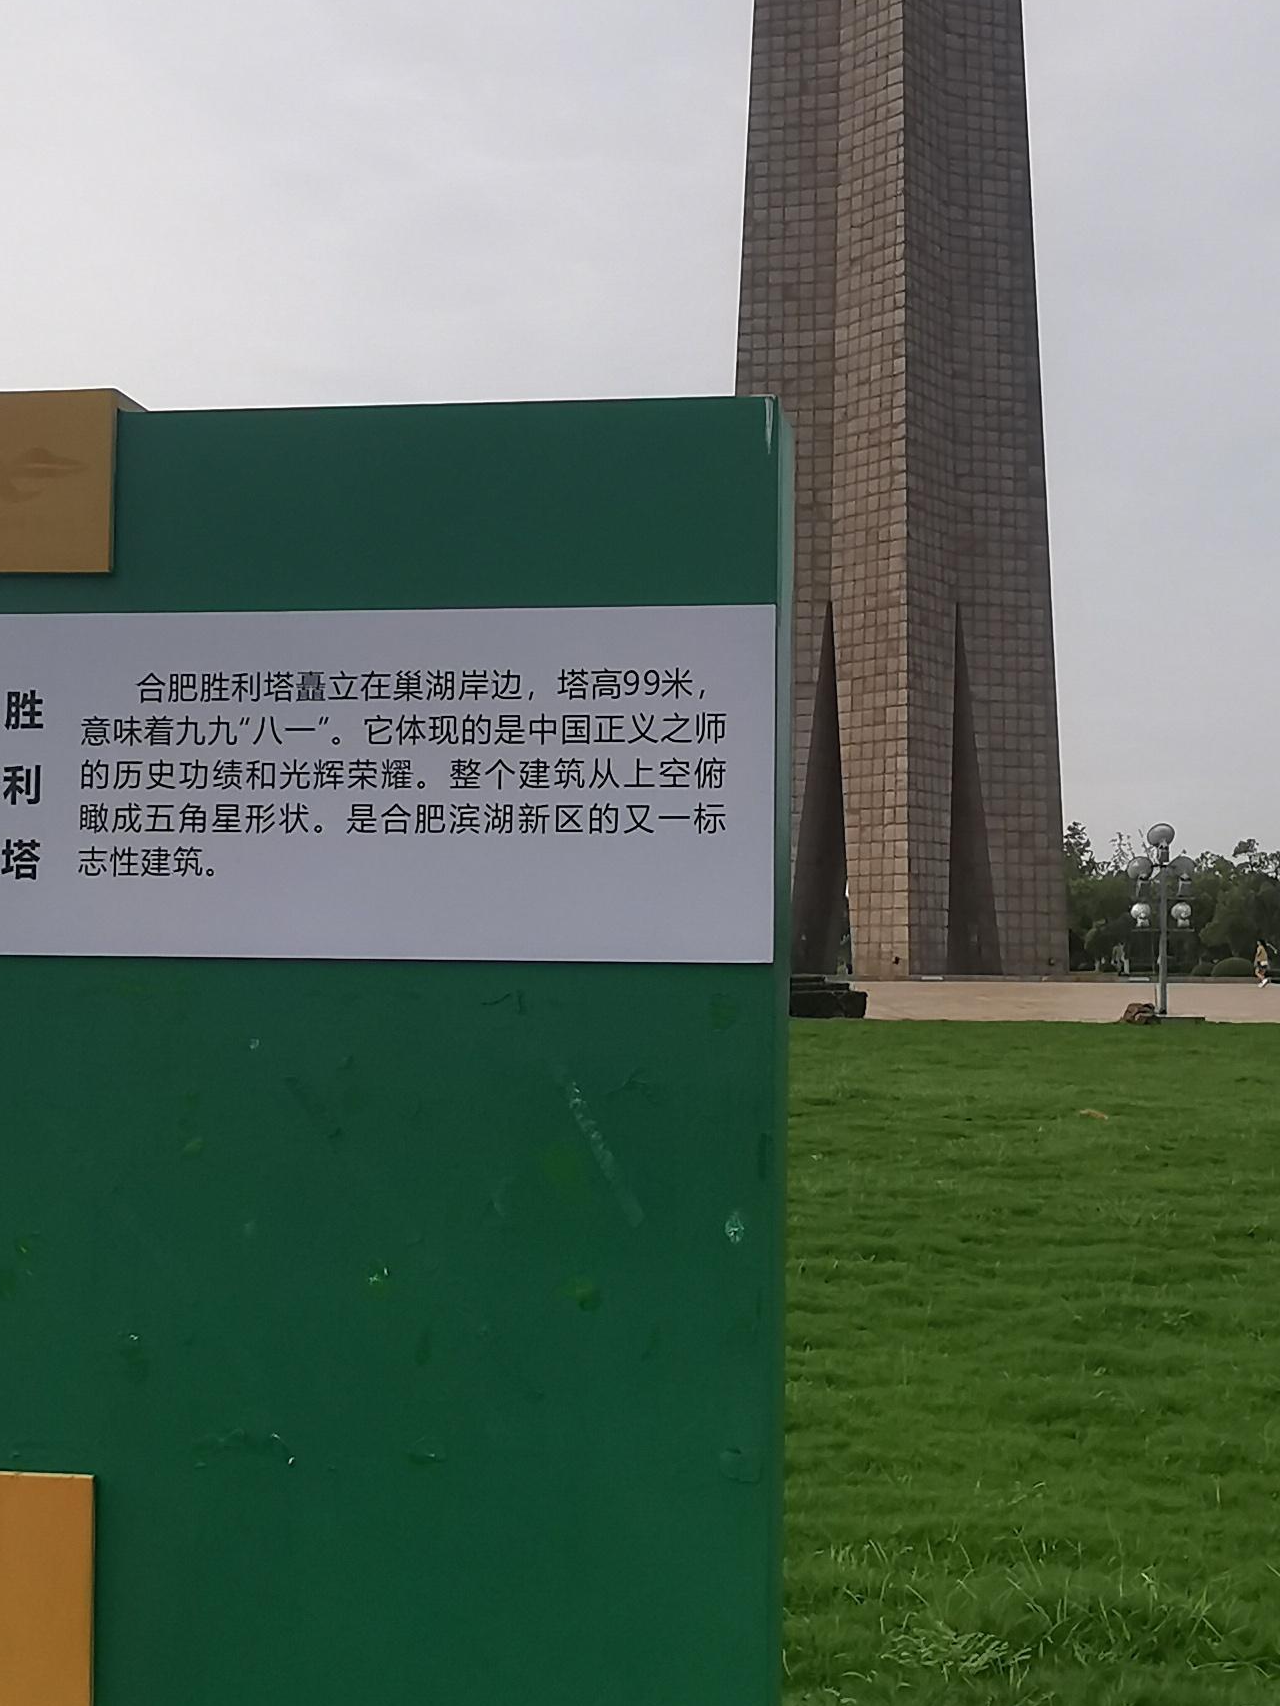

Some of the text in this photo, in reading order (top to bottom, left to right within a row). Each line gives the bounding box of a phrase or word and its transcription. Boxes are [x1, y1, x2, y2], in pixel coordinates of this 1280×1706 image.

[1, 690, 44, 880] 胜利塔
[81, 757, 726, 790] 的历史功绩和光辉荣耀。整个建筑从上空俯
[80, 802, 726, 834] 瞰成五角星形状。是合肥滨湖新区的又一标
[78, 846, 214, 877] 志性建筑。
